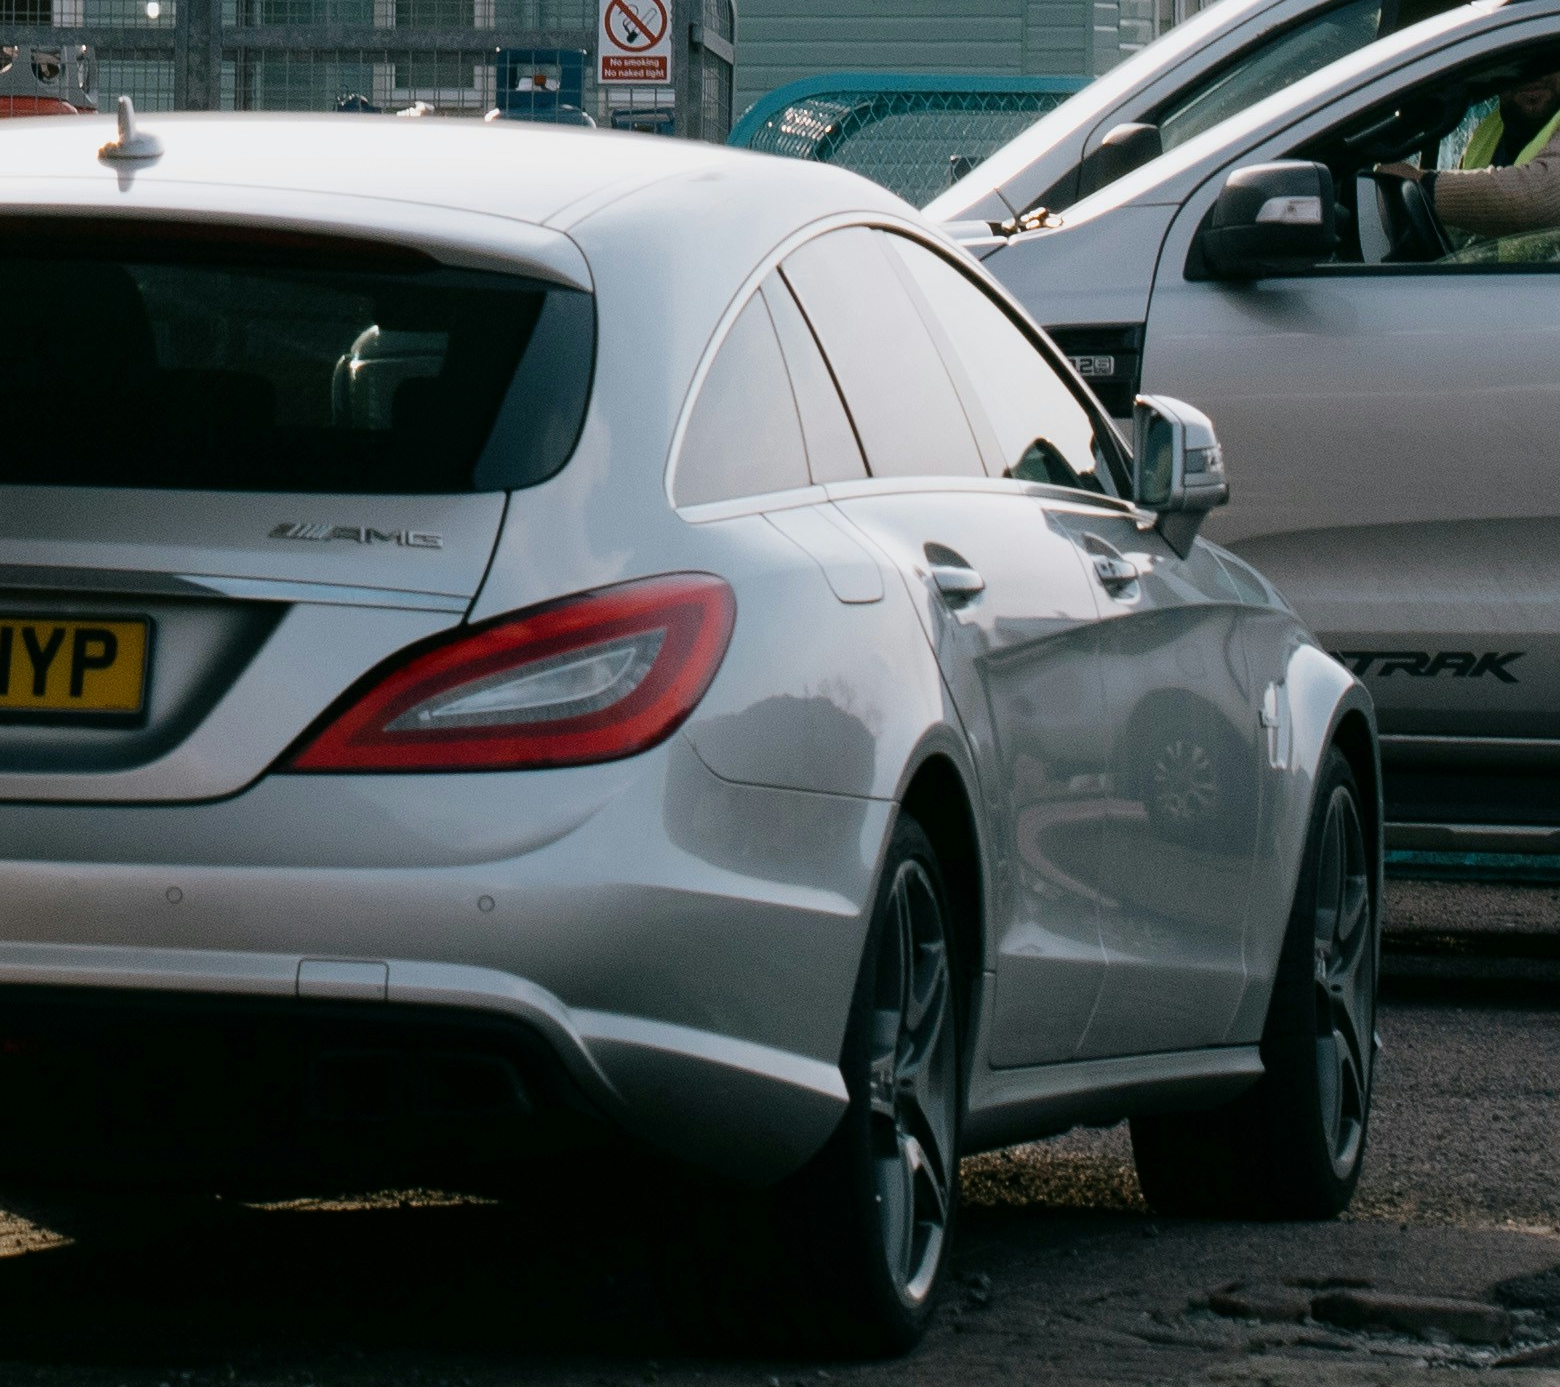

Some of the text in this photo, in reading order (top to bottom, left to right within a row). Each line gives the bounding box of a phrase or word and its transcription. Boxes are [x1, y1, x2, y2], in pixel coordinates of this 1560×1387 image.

[610, 58, 659, 68] No smoking
[604, 69, 664, 78] No naked light
[331, 525, 444, 549] AMG
